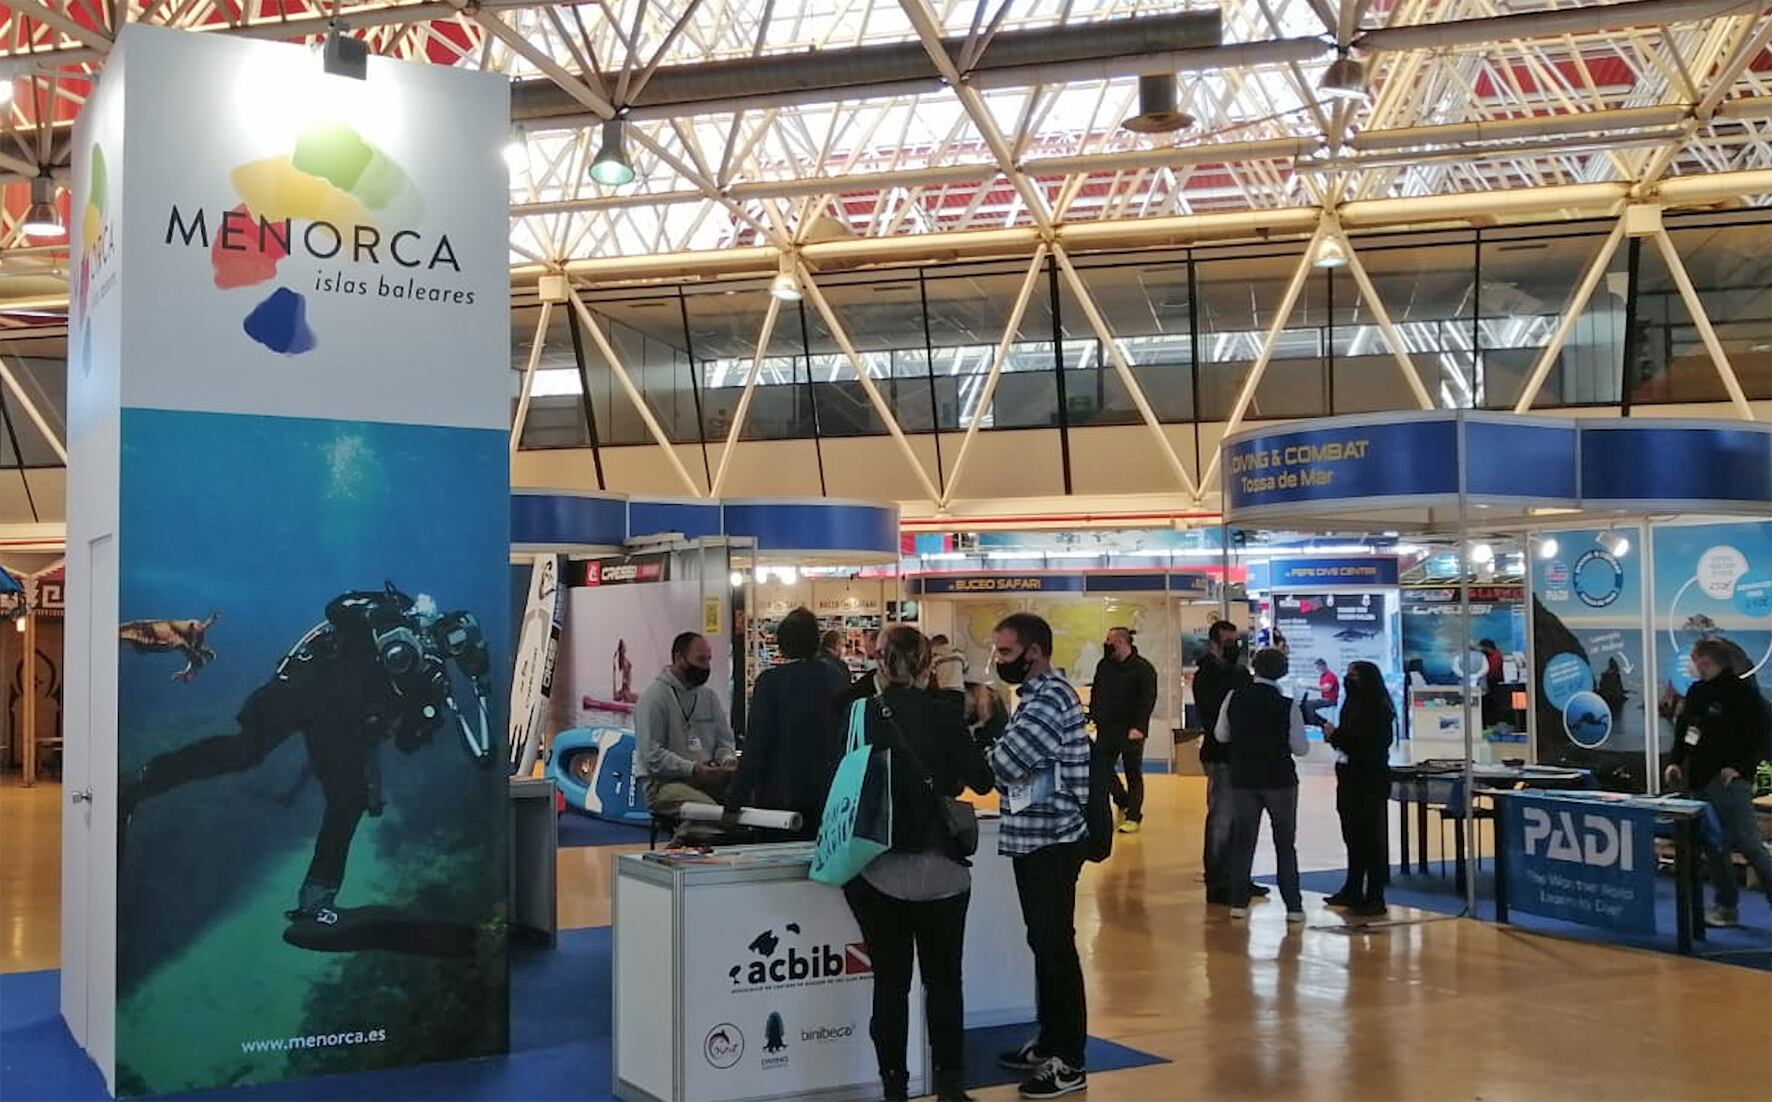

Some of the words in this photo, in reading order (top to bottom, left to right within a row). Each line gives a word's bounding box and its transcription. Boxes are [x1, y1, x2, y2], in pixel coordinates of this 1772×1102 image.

[165, 204, 462, 272] MENORCA
[315, 270, 368, 296] islas
[378, 274, 476, 305] baleares
[1284, 440, 1370, 466] COMBAT
[1241, 475, 1275, 493] Tossa
[1278, 470, 1297, 488] de
[1300, 469, 1334, 486] Mar
[1523, 807, 1634, 872] PADI
[748, 944, 844, 984] acbib
[241, 1028, 386, 1053] www.menorca.es
